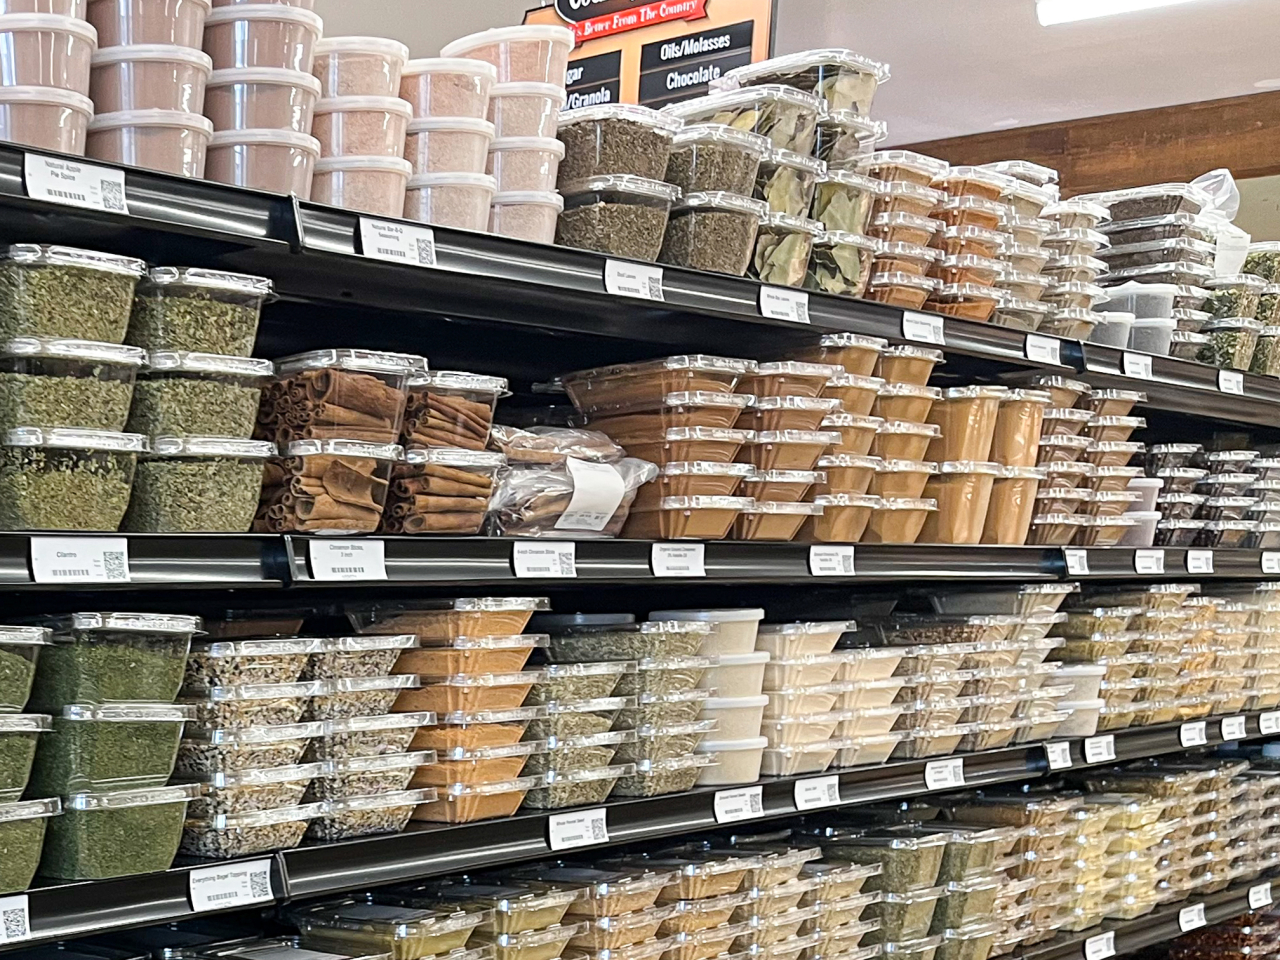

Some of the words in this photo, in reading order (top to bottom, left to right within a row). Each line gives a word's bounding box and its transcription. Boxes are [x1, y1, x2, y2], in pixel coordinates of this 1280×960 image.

[612, 14, 638, 30] From
[639, 6, 658, 23] The
[659, 1, 697, 18] Country
[660, 34, 730, 61] Oils/Molasses
[565, 66, 584, 85] gar
[666, 66, 720, 90] Chocolate
[562, 86, 611, 111] /Granola
[50, 169, 60, 178] Pie
[61, 171, 76, 182] Spice
[56, 551, 77, 559] Cilantro
[192, 876, 216, 884] Everything
